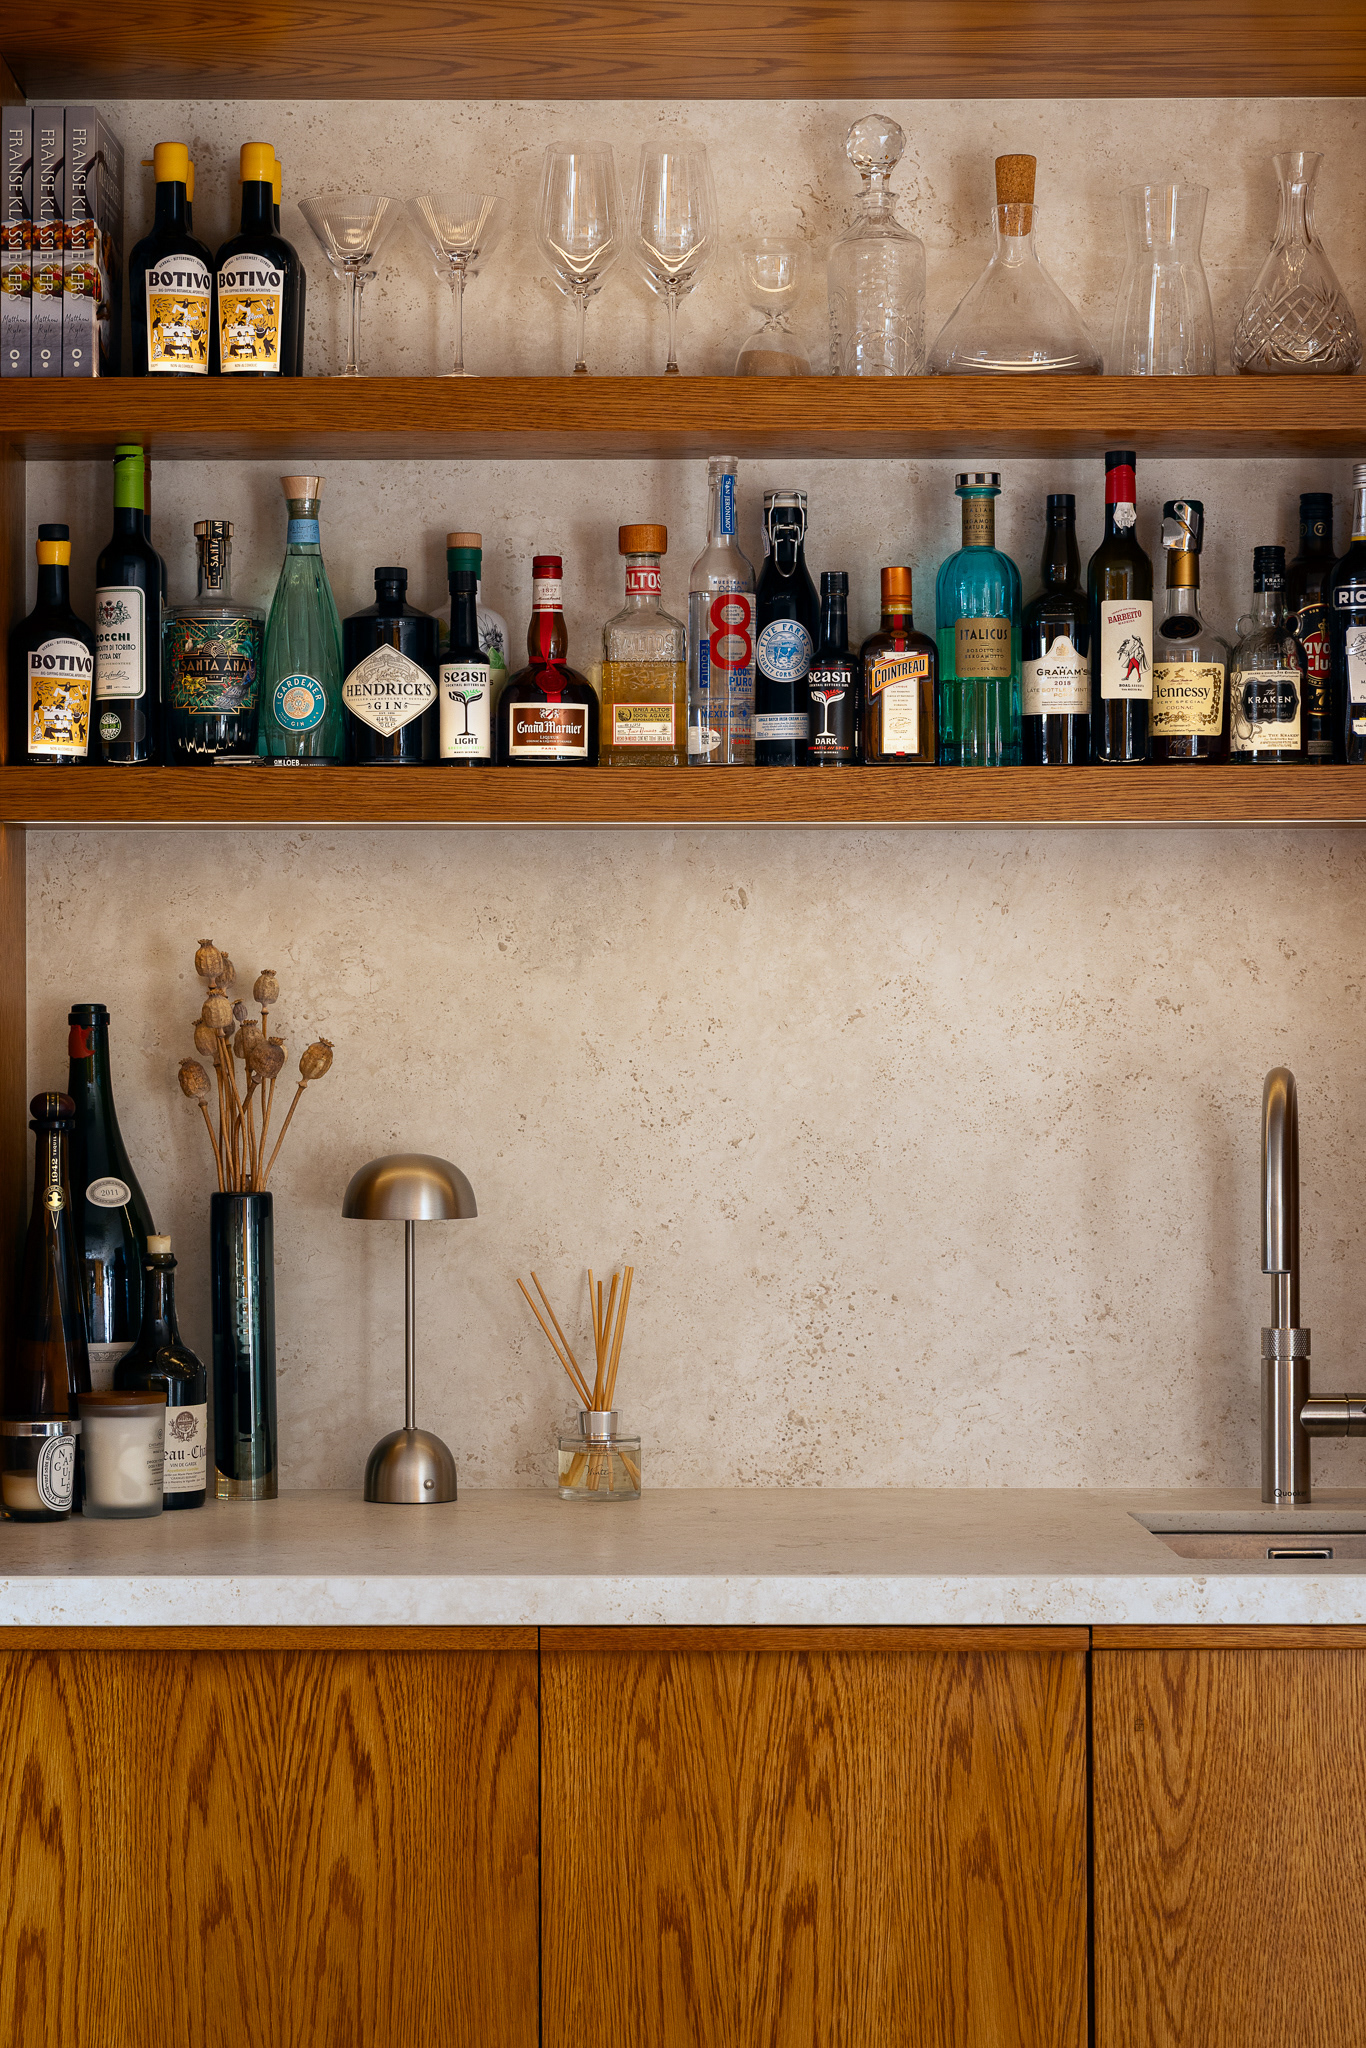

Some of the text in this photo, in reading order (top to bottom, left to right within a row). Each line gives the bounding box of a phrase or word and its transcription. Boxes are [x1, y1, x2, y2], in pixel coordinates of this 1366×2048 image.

[8, 129, 23, 301] FRANSE KLASSIEKERS
[40, 129, 55, 301] FRANSE KLASSIEKERS
[71, 128, 87, 300] FRANSE KLASSIEKERS
[148, 271, 210, 290] BOTIVO
[218, 271, 281, 289] BOTIVO
[2, 314, 28, 324] Matthew
[33, 314, 59, 324] Matthew
[64, 313, 90, 323] Matthew
[6, 324, 22, 339] Ryle
[37, 324, 53, 339] Ryle
[68, 323, 84, 338] Ryle
[214, 521, 223, 535] AN
[1317, 525, 1324, 534] 7
[210, 537, 221, 568] SANTA
[718, 585, 743, 593] OCHO
[1338, 590, 1366, 604] RIC
[1107, 610, 1142, 624] BARBEITO
[709, 594, 752, 670] 8
[760, 623, 809, 648] FIVE FARMS
[960, 629, 1008, 640] ITALICUS
[115, 643, 137, 651] TORINO
[31, 654, 92, 672] BOTIVO
[180, 659, 248, 672] SANTA ANA
[1307, 654, 1332, 671] Clu
[443, 671, 487, 683] seasn
[775, 670, 792, 678] CORK
[808, 671, 851, 684] seasn
[873, 658, 926, 689] COINTREAU
[1036, 668, 1088, 676] GRAHAM'S
[729, 676, 753, 687] PURO
[276, 678, 323, 701] GARDENER
[346, 682, 432, 697] HENDRICK'S
[1153, 685, 1211, 701] Hennessy
[1247, 696, 1291, 704] KRAKEN
[1315, 688, 1326, 706] 7
[373, 701, 402, 710] GIN
[701, 710, 735, 718] MEXICO
[516, 720, 583, 735] Grand Marnier
[454, 737, 479, 745] LIGHT
[815, 737, 838, 745] DARK
[283, 759, 300, 767] LOEB
[51, 1158, 59, 1182] 1942
[100, 1189, 119, 1197] 2011
